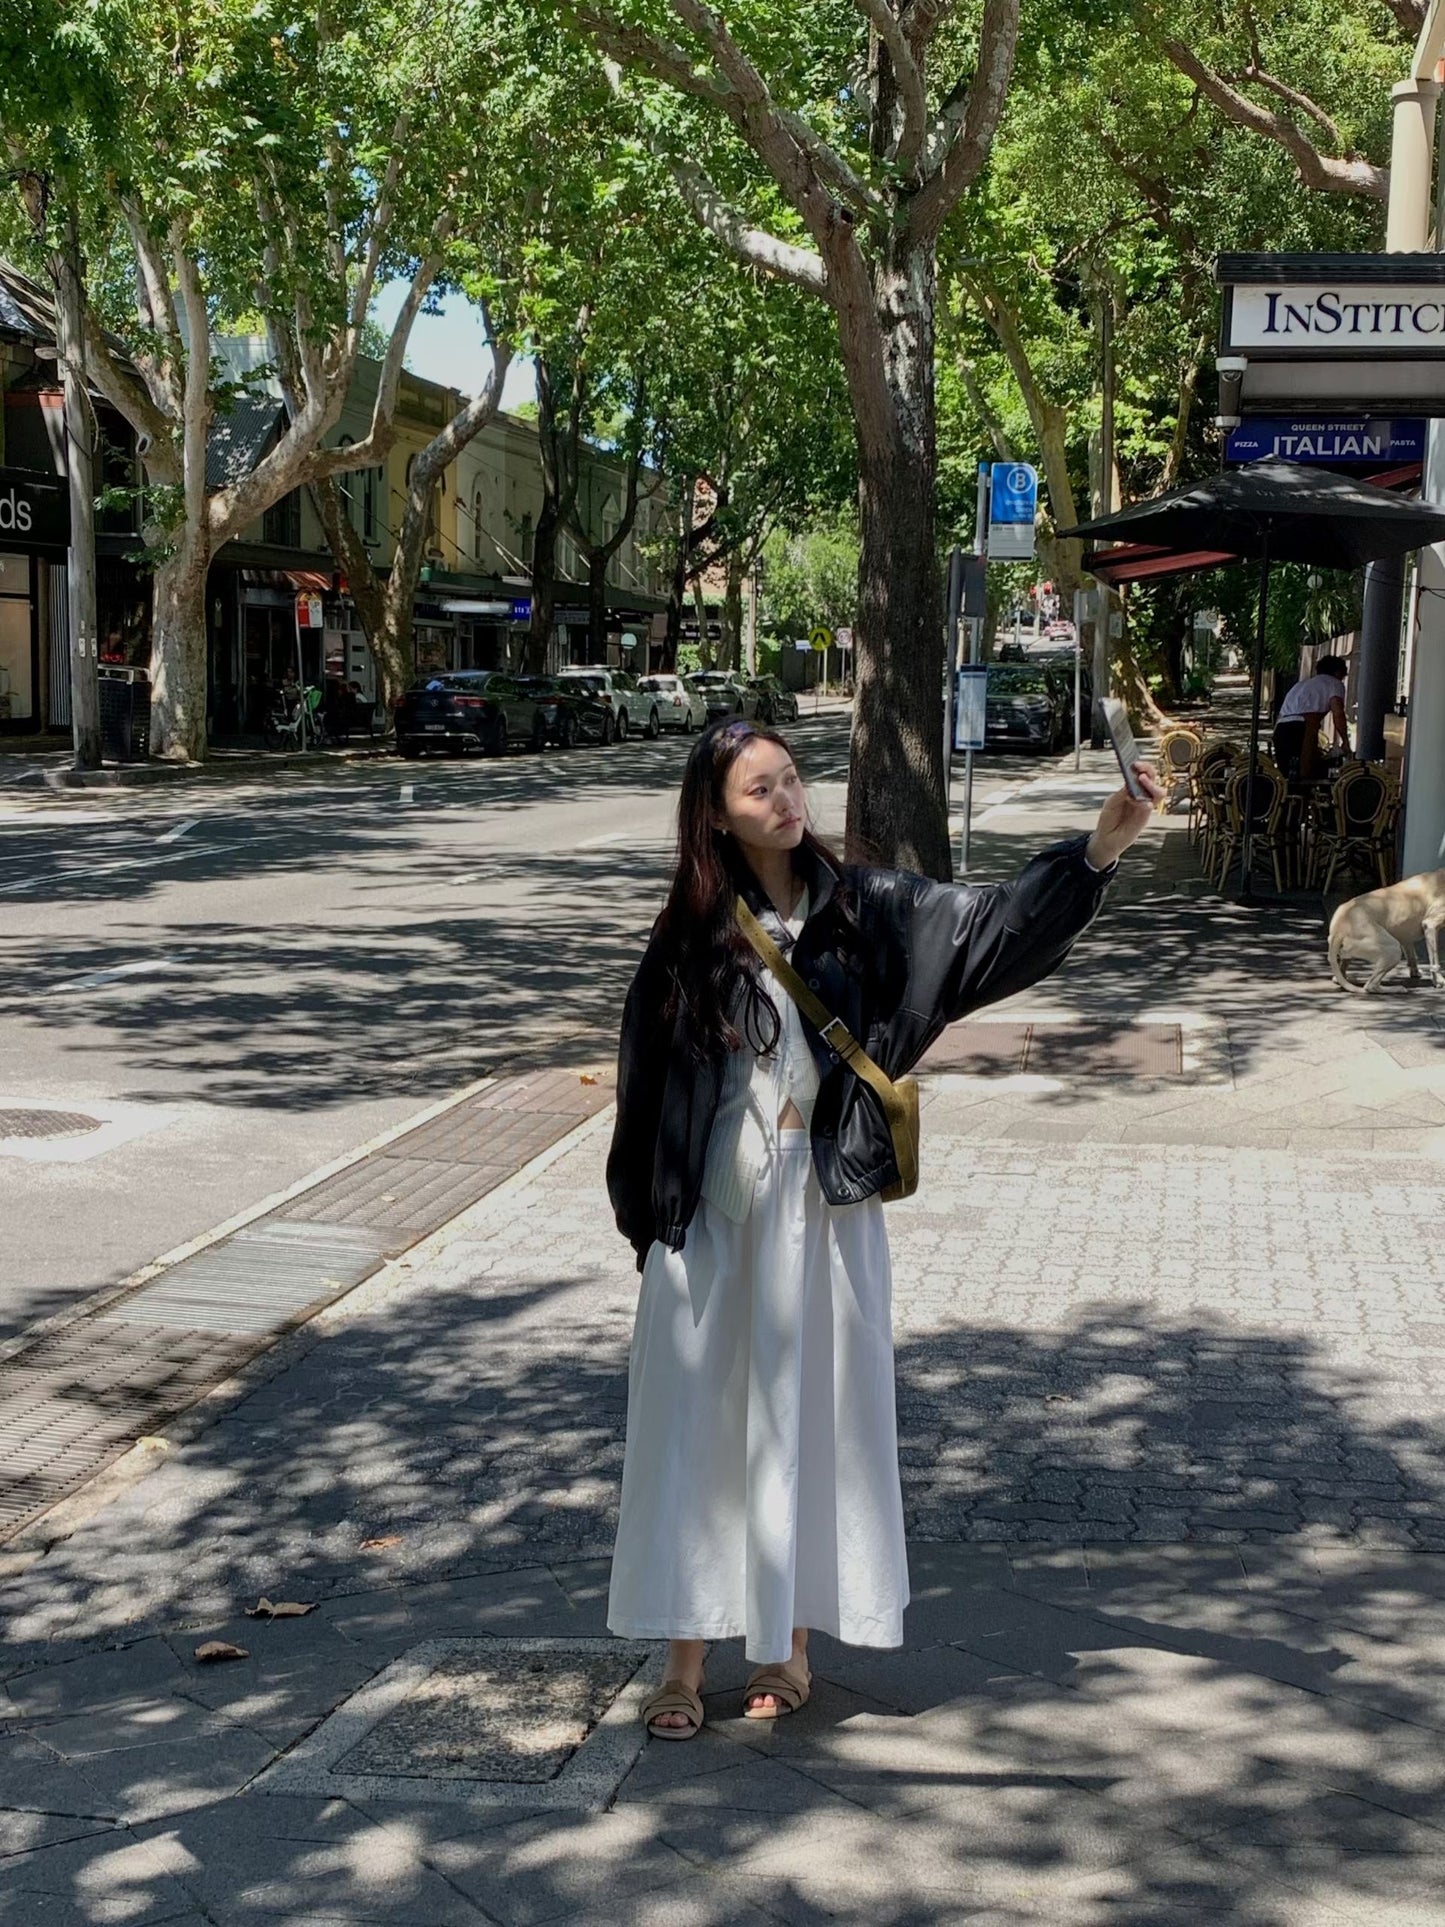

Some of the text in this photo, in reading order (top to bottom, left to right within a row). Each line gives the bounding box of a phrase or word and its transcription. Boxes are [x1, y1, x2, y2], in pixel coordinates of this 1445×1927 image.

[1291, 424, 1365, 432] QUEEN STREET
[1273, 436, 1381, 456] ITALIAN
[1389, 439, 1416, 447] PASTA
[1015, 472, 1026, 489] B
